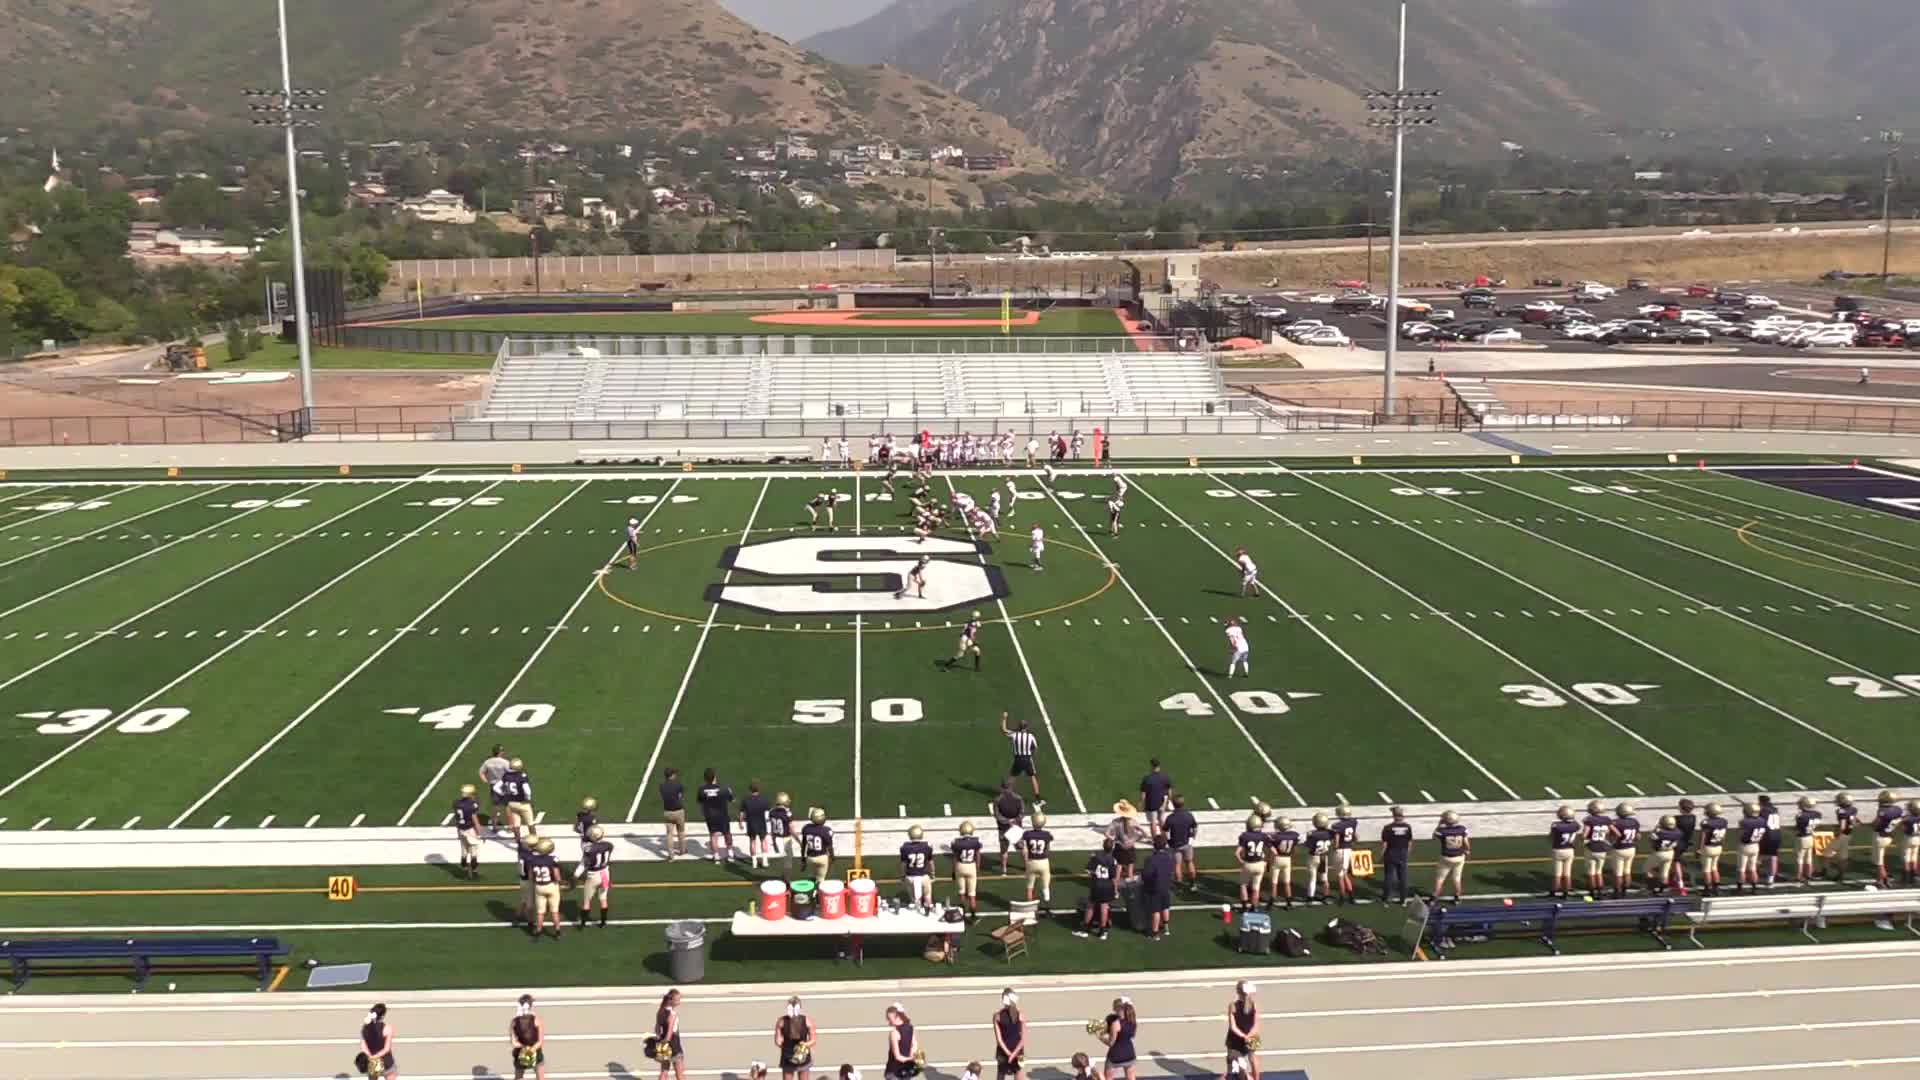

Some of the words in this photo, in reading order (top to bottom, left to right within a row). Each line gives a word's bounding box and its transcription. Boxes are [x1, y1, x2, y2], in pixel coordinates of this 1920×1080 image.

[1159, 691, 1290, 715] 40
[1500, 682, 1641, 707] 30
[37, 707, 190, 734] 30
[418, 703, 556, 729] 40
[792, 698, 923, 724] 50
[1352, 856, 1372, 873] 40
[330, 878, 351, 898] 40
